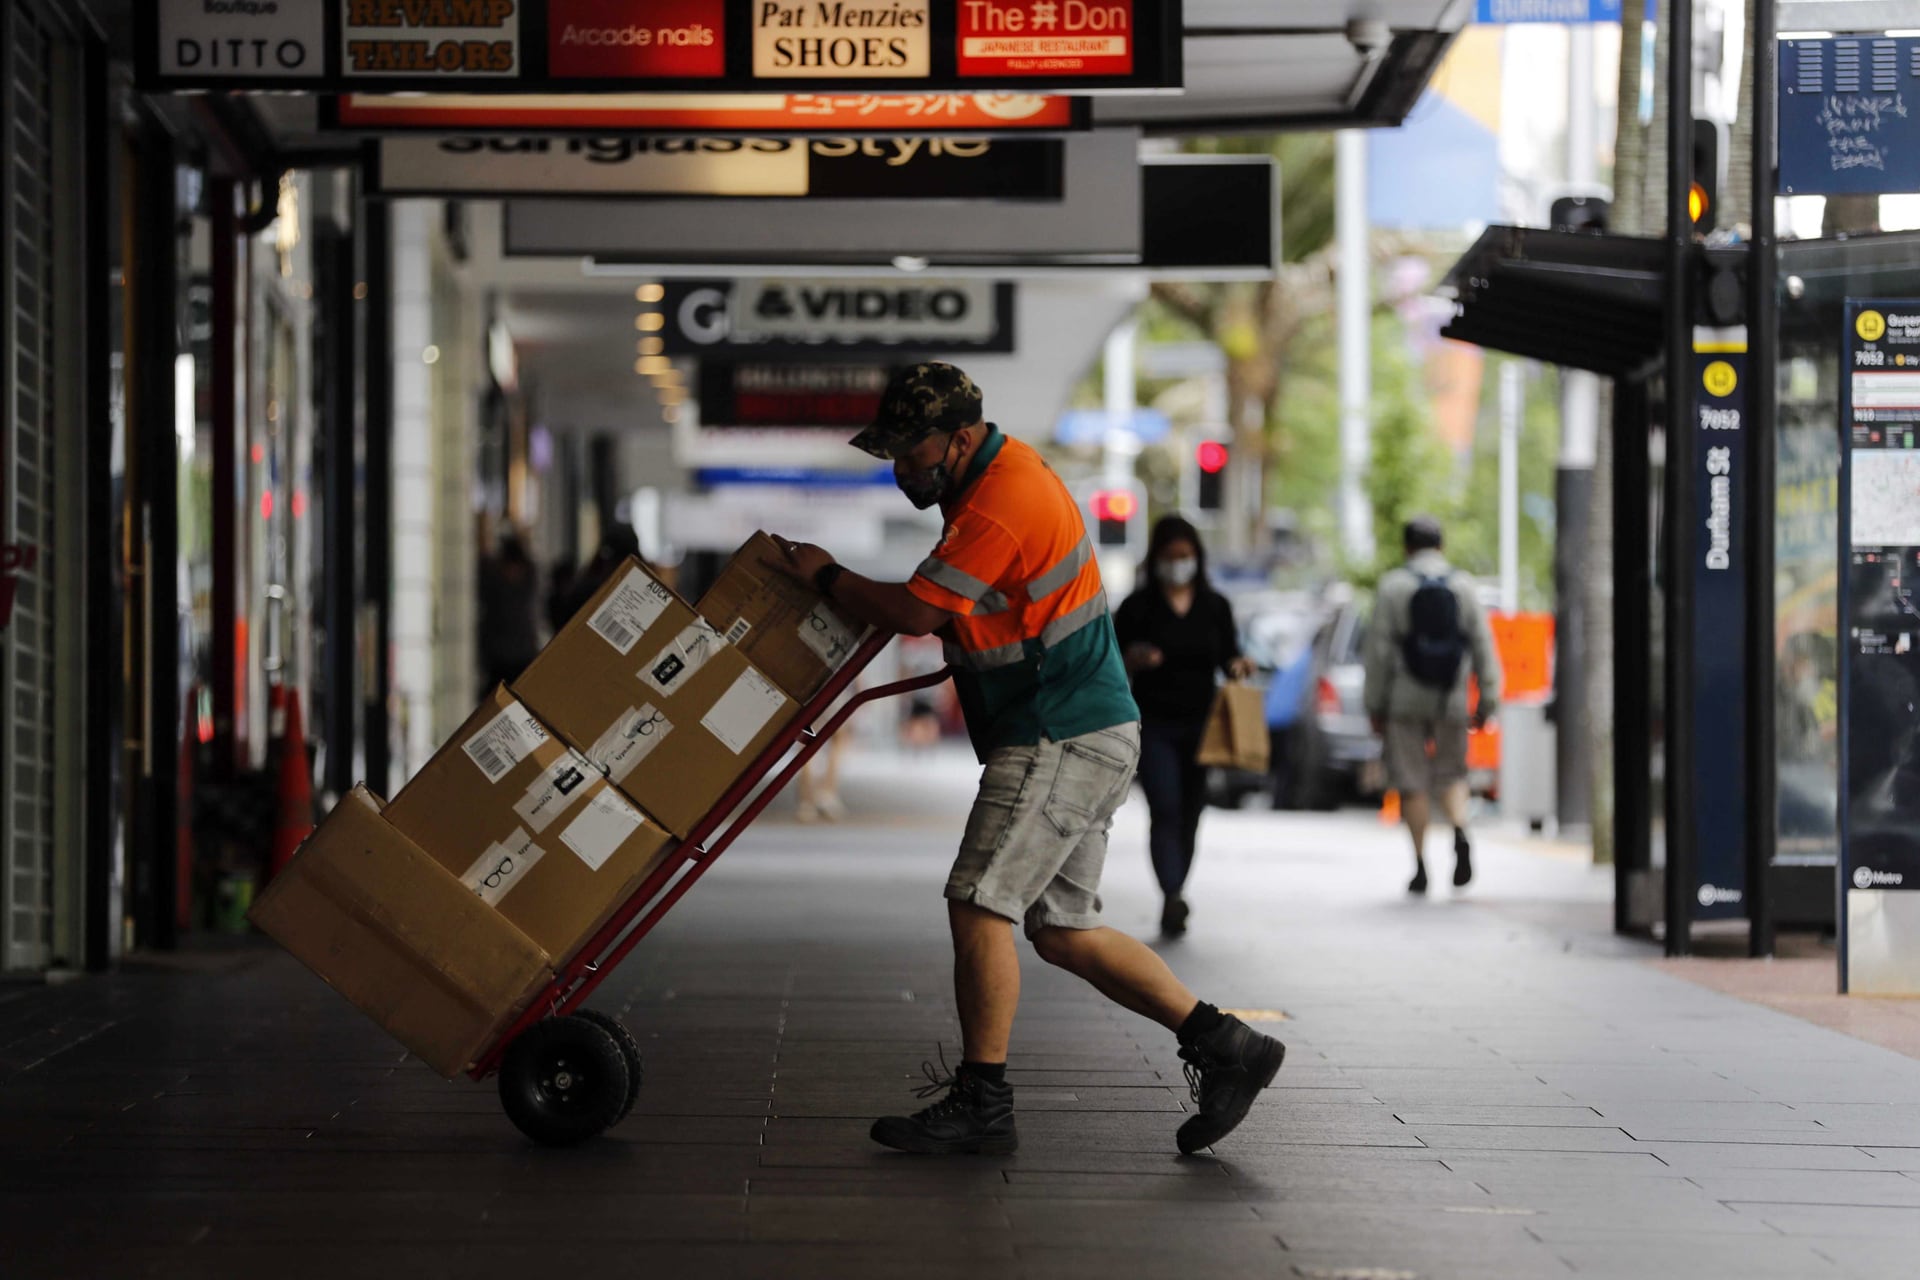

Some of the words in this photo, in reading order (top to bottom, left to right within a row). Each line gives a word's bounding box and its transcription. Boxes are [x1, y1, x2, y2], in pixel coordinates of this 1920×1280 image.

[204, 0, 278, 15] Boutique
[348, 0, 513, 27] REVAMP
[760, 2, 804, 27] Pat
[814, 2, 926, 27] Menzies
[964, 1, 1024, 31] The
[1064, 1, 1126, 31] Don
[559, 24, 652, 46] Arcade
[657, 24, 714, 46] nails
[982, 41, 1033, 52] JAPANESE
[1040, 40, 1109, 52] RESTAURANT
[177, 39, 305, 69] DITTO
[348, 40, 513, 72] TAILORS
[774, 37, 907, 67] SHOES
[1855, 350, 1884, 366] 7052
[1700, 408, 1740, 430] 7052
[1706, 446, 1730, 475] St
[1705, 476, 1730, 569] Durham
[646, 579, 671, 603] AUCK
[526, 717, 550, 740] AUCK
